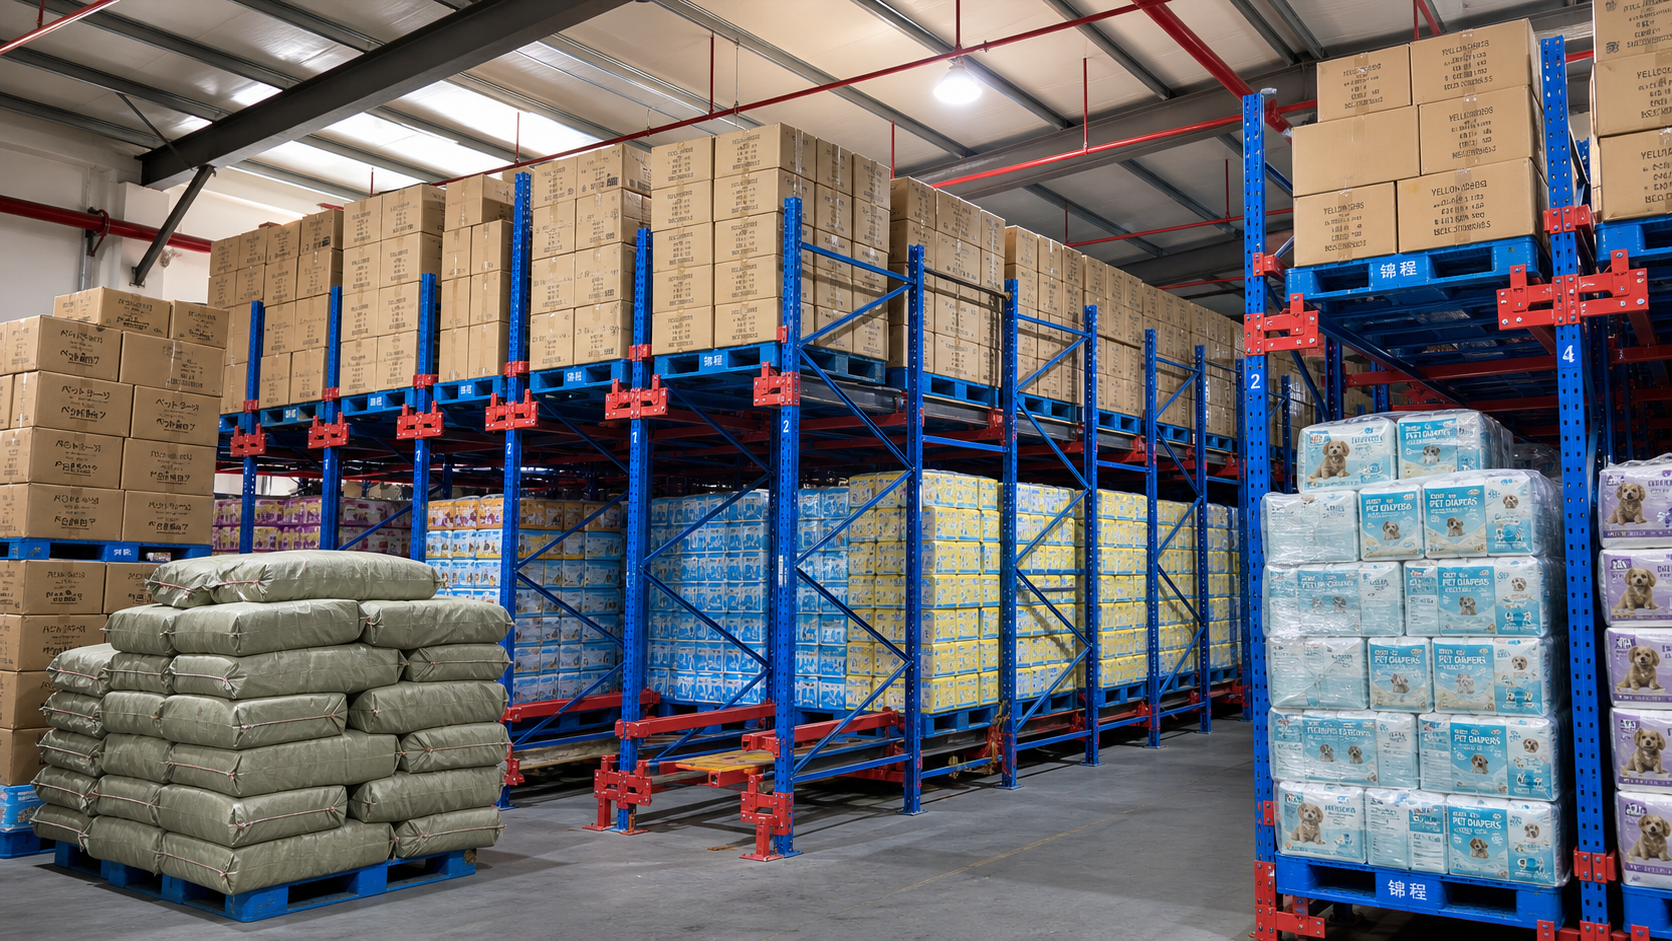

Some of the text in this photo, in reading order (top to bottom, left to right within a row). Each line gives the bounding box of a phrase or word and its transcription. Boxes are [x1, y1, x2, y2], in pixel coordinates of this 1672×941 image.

[1380, 261, 1417, 279] 锦程
[1562, 344, 1575, 363] 4
[1250, 373, 1261, 389] 2
[783, 419, 789, 433] 2
[632, 431, 638, 444] 1
[1387, 879, 1427, 901] 锦程
